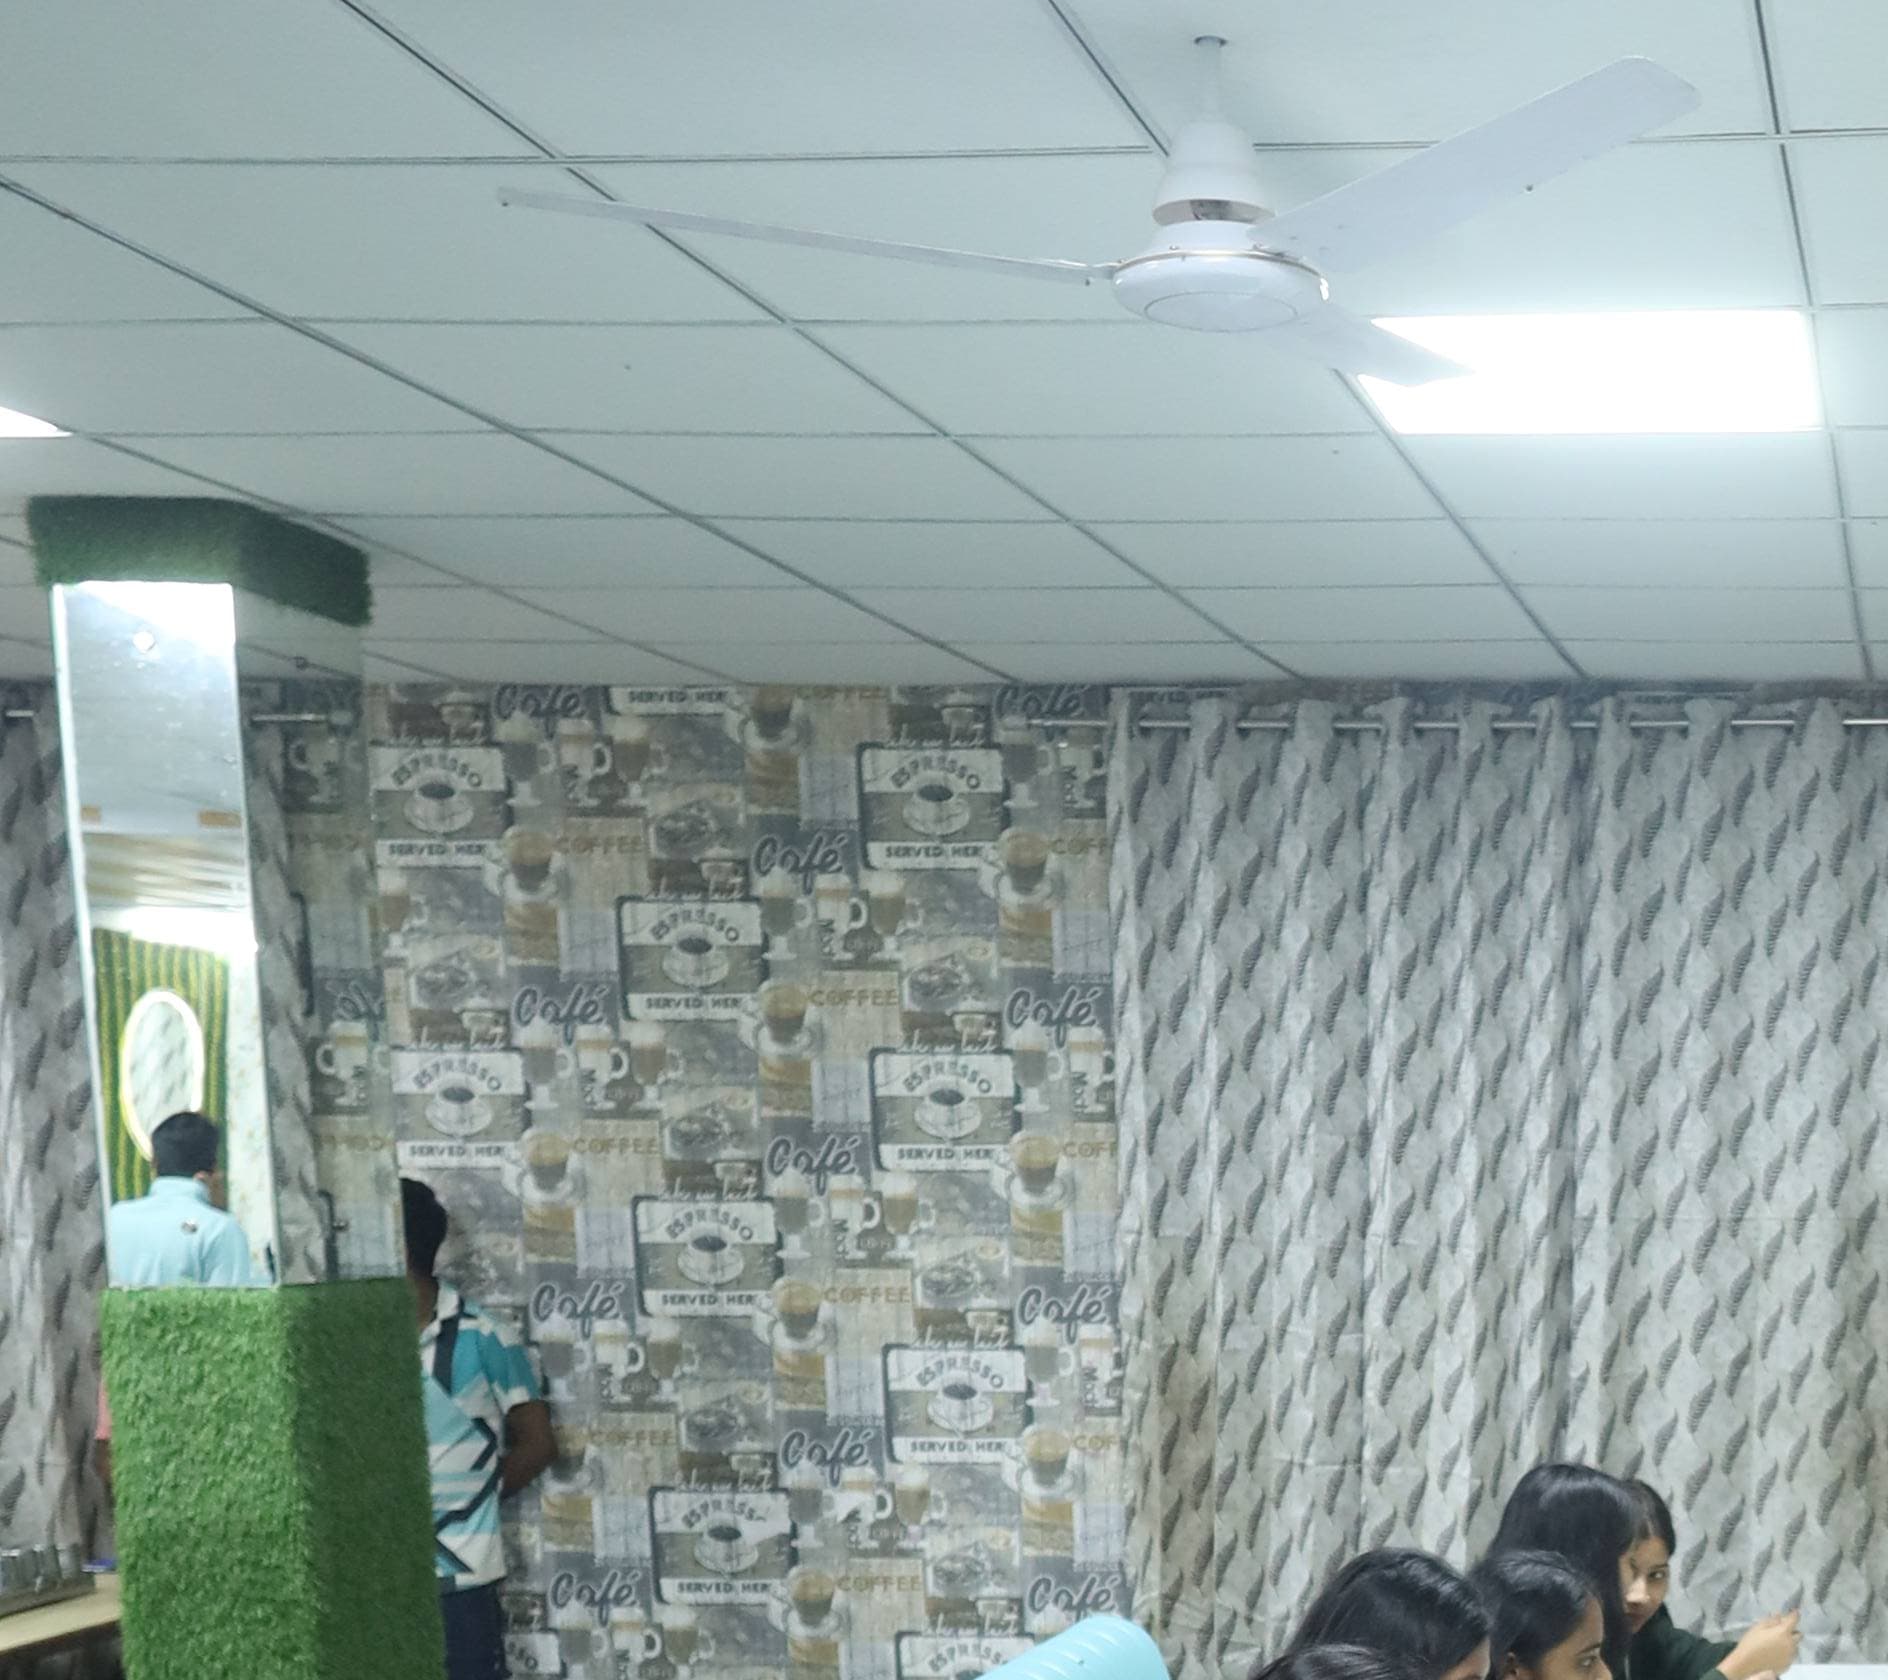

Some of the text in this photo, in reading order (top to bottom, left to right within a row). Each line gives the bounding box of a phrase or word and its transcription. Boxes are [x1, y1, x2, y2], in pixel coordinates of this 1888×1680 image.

[892, 756, 981, 789] ESPRESSO
[752, 831, 849, 896] Café
[886, 846, 943, 858] SERVED
[652, 908, 740, 942] ESPRESSO
[647, 997, 703, 1009] SERVED
[809, 990, 898, 1006] COFFEE
[511, 983, 609, 1046] Café
[1005, 985, 1101, 1049] Café
[413, 1059, 502, 1091] ESPRESSO
[903, 1062, 992, 1093] ESPRESSO
[410, 1145, 466, 1157] SERVED
[574, 1137, 658, 1154] COFFEE
[897, 1148, 955, 1160] SERVED
[766, 1135, 861, 1197] Café
[665, 1209, 753, 1240] ESPRESSO
[531, 1279, 624, 1339] Café
[662, 1293, 718, 1305] SERVED
[824, 1287, 911, 1304] COFFEE
[1017, 1284, 1113, 1345] Café
[916, 1356, 1004, 1388] ESPRESSO
[780, 1427, 874, 1488] Café
[911, 1441, 966, 1453] SERVED
[681, 1498, 766, 1528] ESPRESS
[678, 1582, 733, 1594] SERVED
[838, 1574, 922, 1591] COFFEE
[1029, 1574, 1121, 1620] Café
[551, 1570, 641, 1628] Café
[928, 1644, 1007, 1672] ESPRESS
